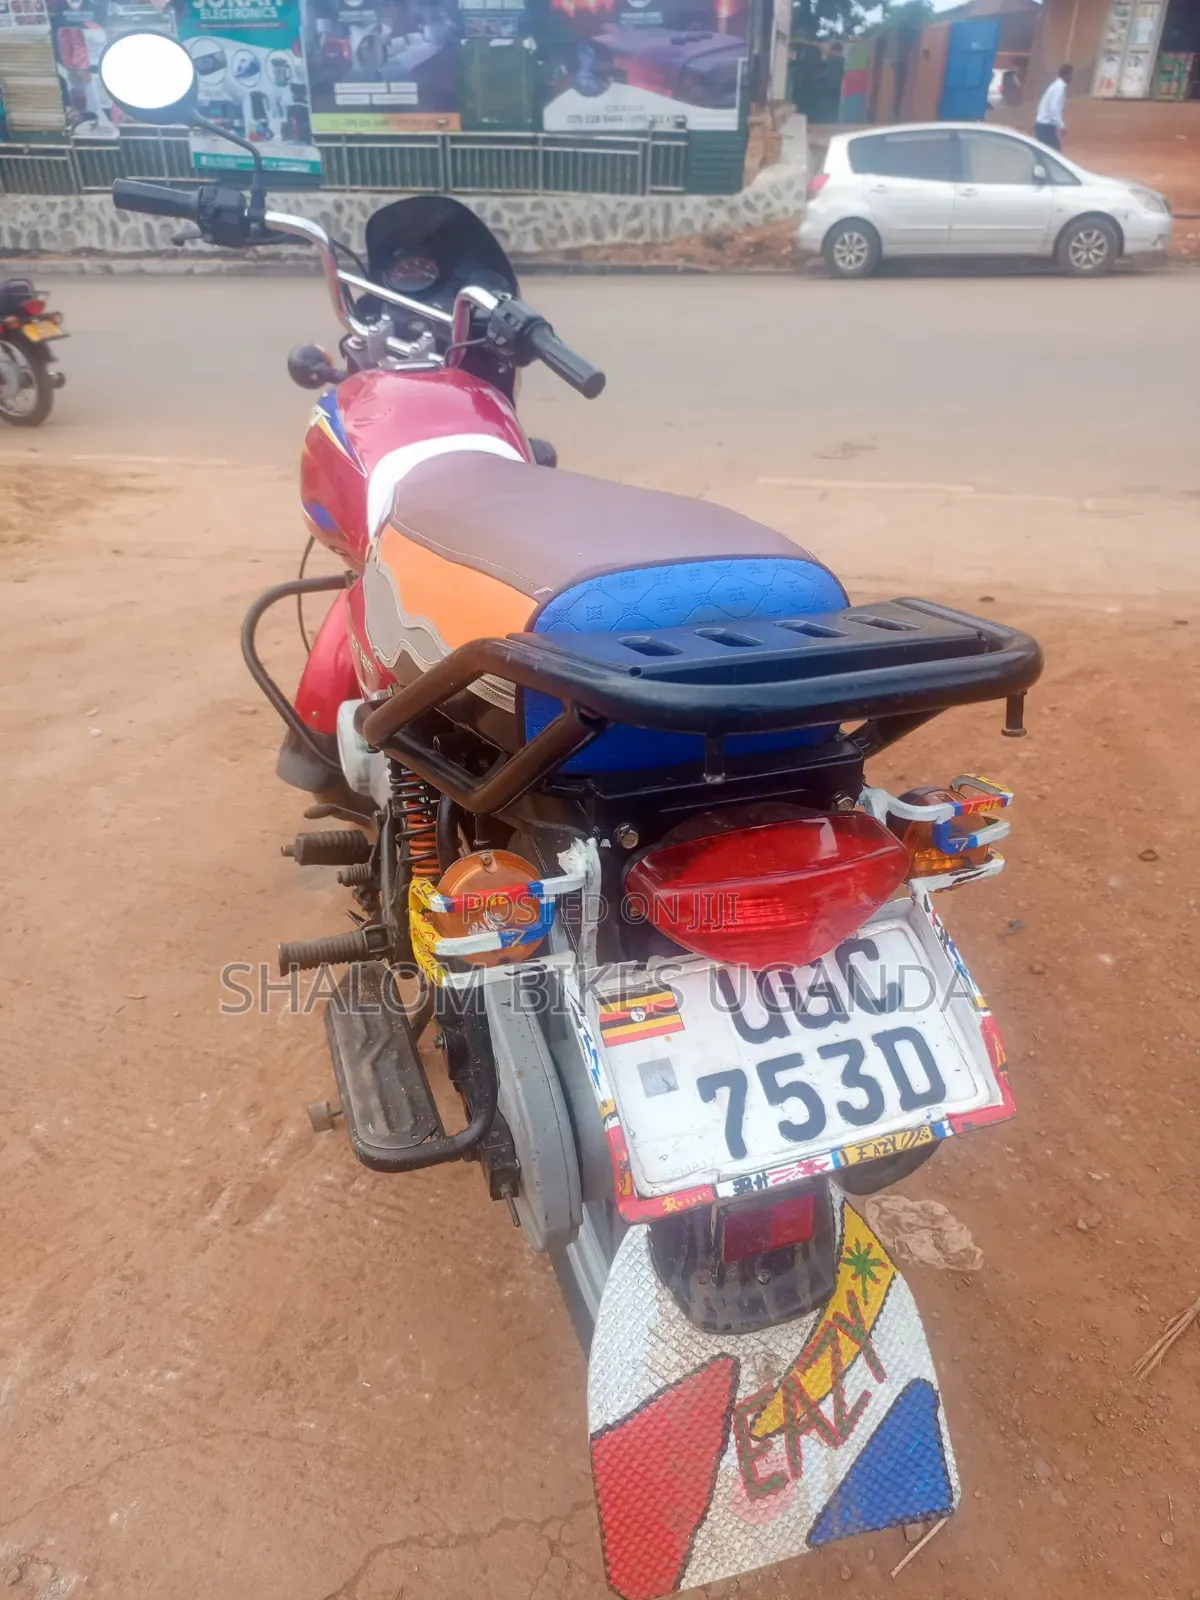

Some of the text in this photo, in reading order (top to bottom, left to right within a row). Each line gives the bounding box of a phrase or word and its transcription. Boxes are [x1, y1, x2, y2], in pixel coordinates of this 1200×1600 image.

[200, 7, 279, 19] ELECTRONICS
[696, 1026, 947, 1160] 753D
[732, 1289, 888, 1502] EAZY
